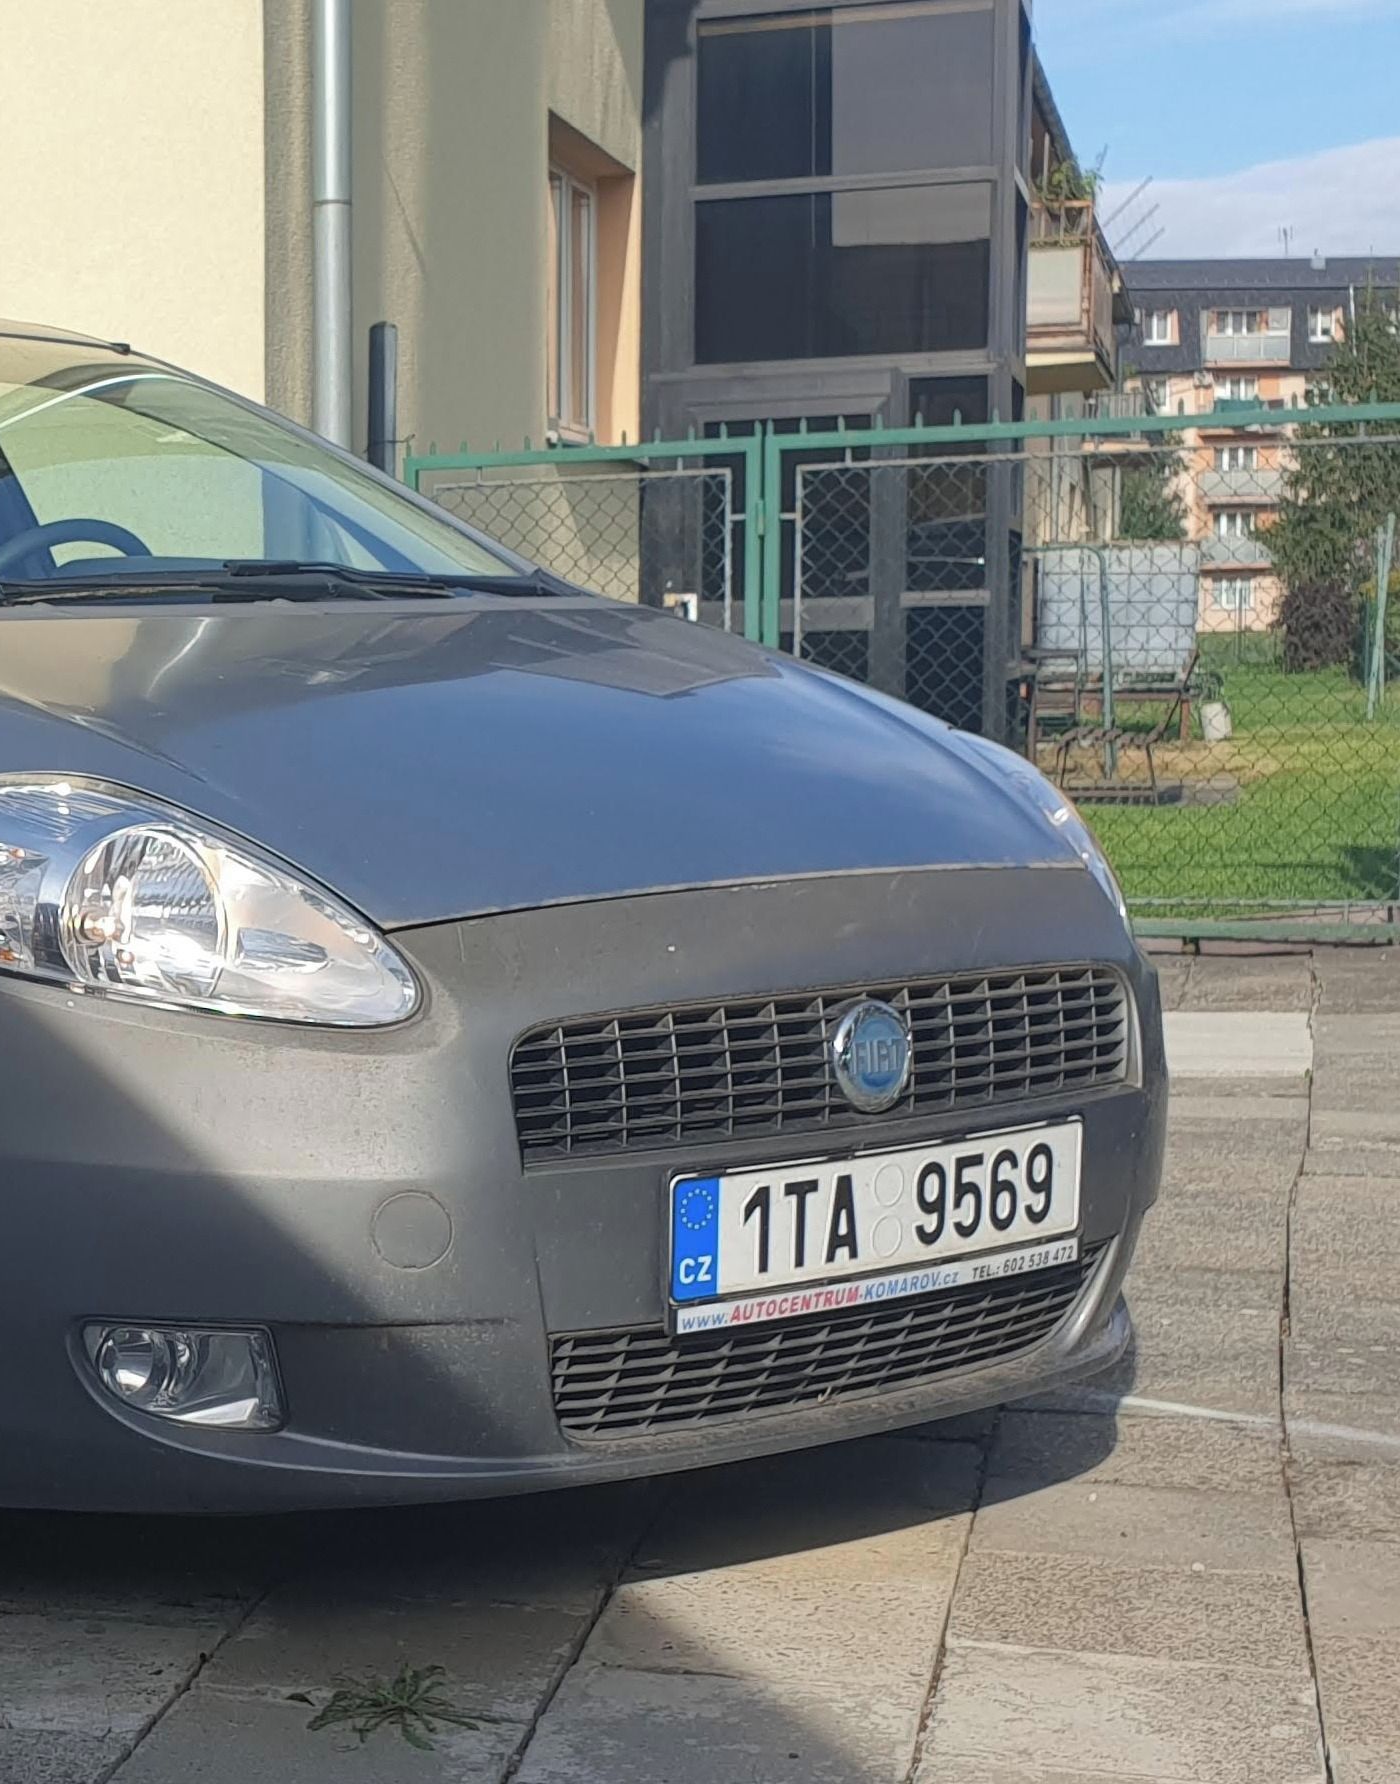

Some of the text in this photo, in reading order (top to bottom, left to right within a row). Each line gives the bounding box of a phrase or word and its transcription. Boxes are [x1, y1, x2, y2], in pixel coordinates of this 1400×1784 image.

[851, 1037, 904, 1075] FIAT
[742, 1142, 1054, 1273] 1TA 9569
[679, 1255, 713, 1285] CZ
[1002, 1256, 1025, 1274] 602
[1029, 1250, 1049, 1268] 538
[1053, 1245, 1074, 1262] 472
